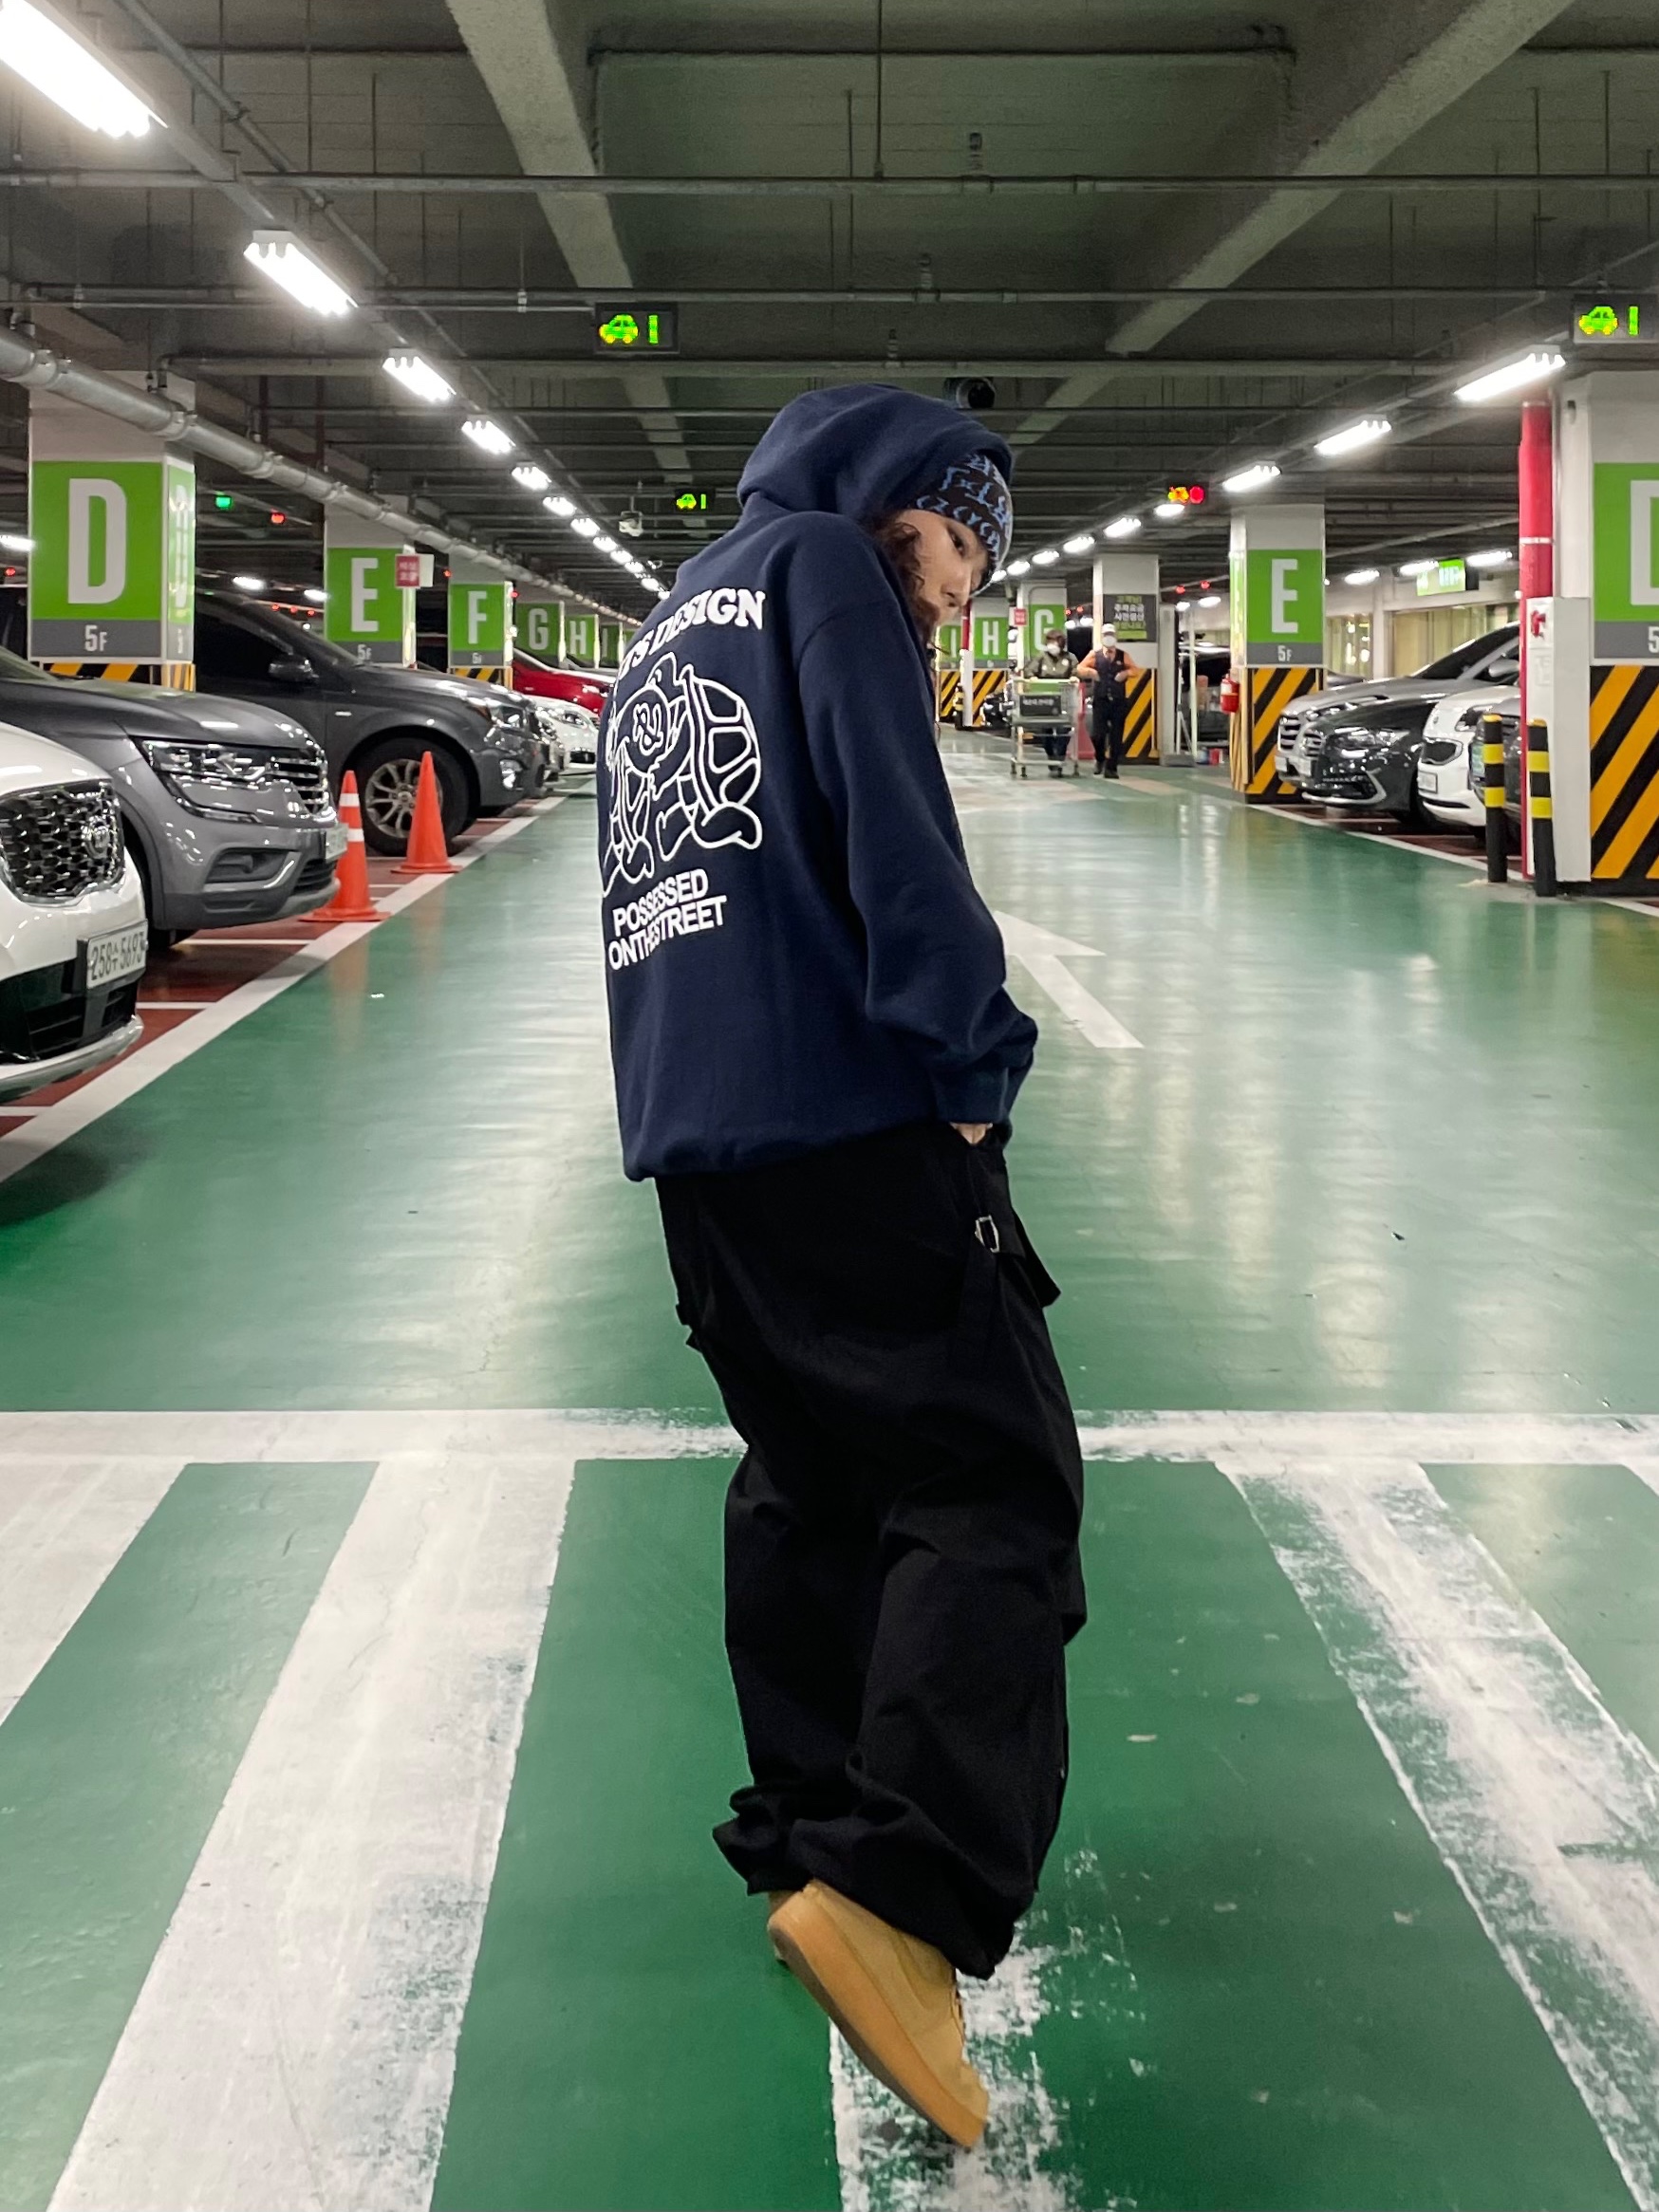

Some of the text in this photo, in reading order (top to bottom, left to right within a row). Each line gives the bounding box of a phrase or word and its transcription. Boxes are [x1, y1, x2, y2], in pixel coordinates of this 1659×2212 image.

[67, 477, 127, 604] D
[350, 557, 379, 633] E
[467, 590, 487, 645] F
[1271, 558, 1298, 634] E
[84, 623, 108, 652] 5F
[528, 607, 549, 651] G
[569, 620, 587, 656] H
[648, 587, 767, 656] DESIGN
[981, 620, 1000, 656] H
[357, 643, 372, 661] 5F
[1277, 644, 1293, 662] 5F
[612, 867, 710, 938] POSSESSED
